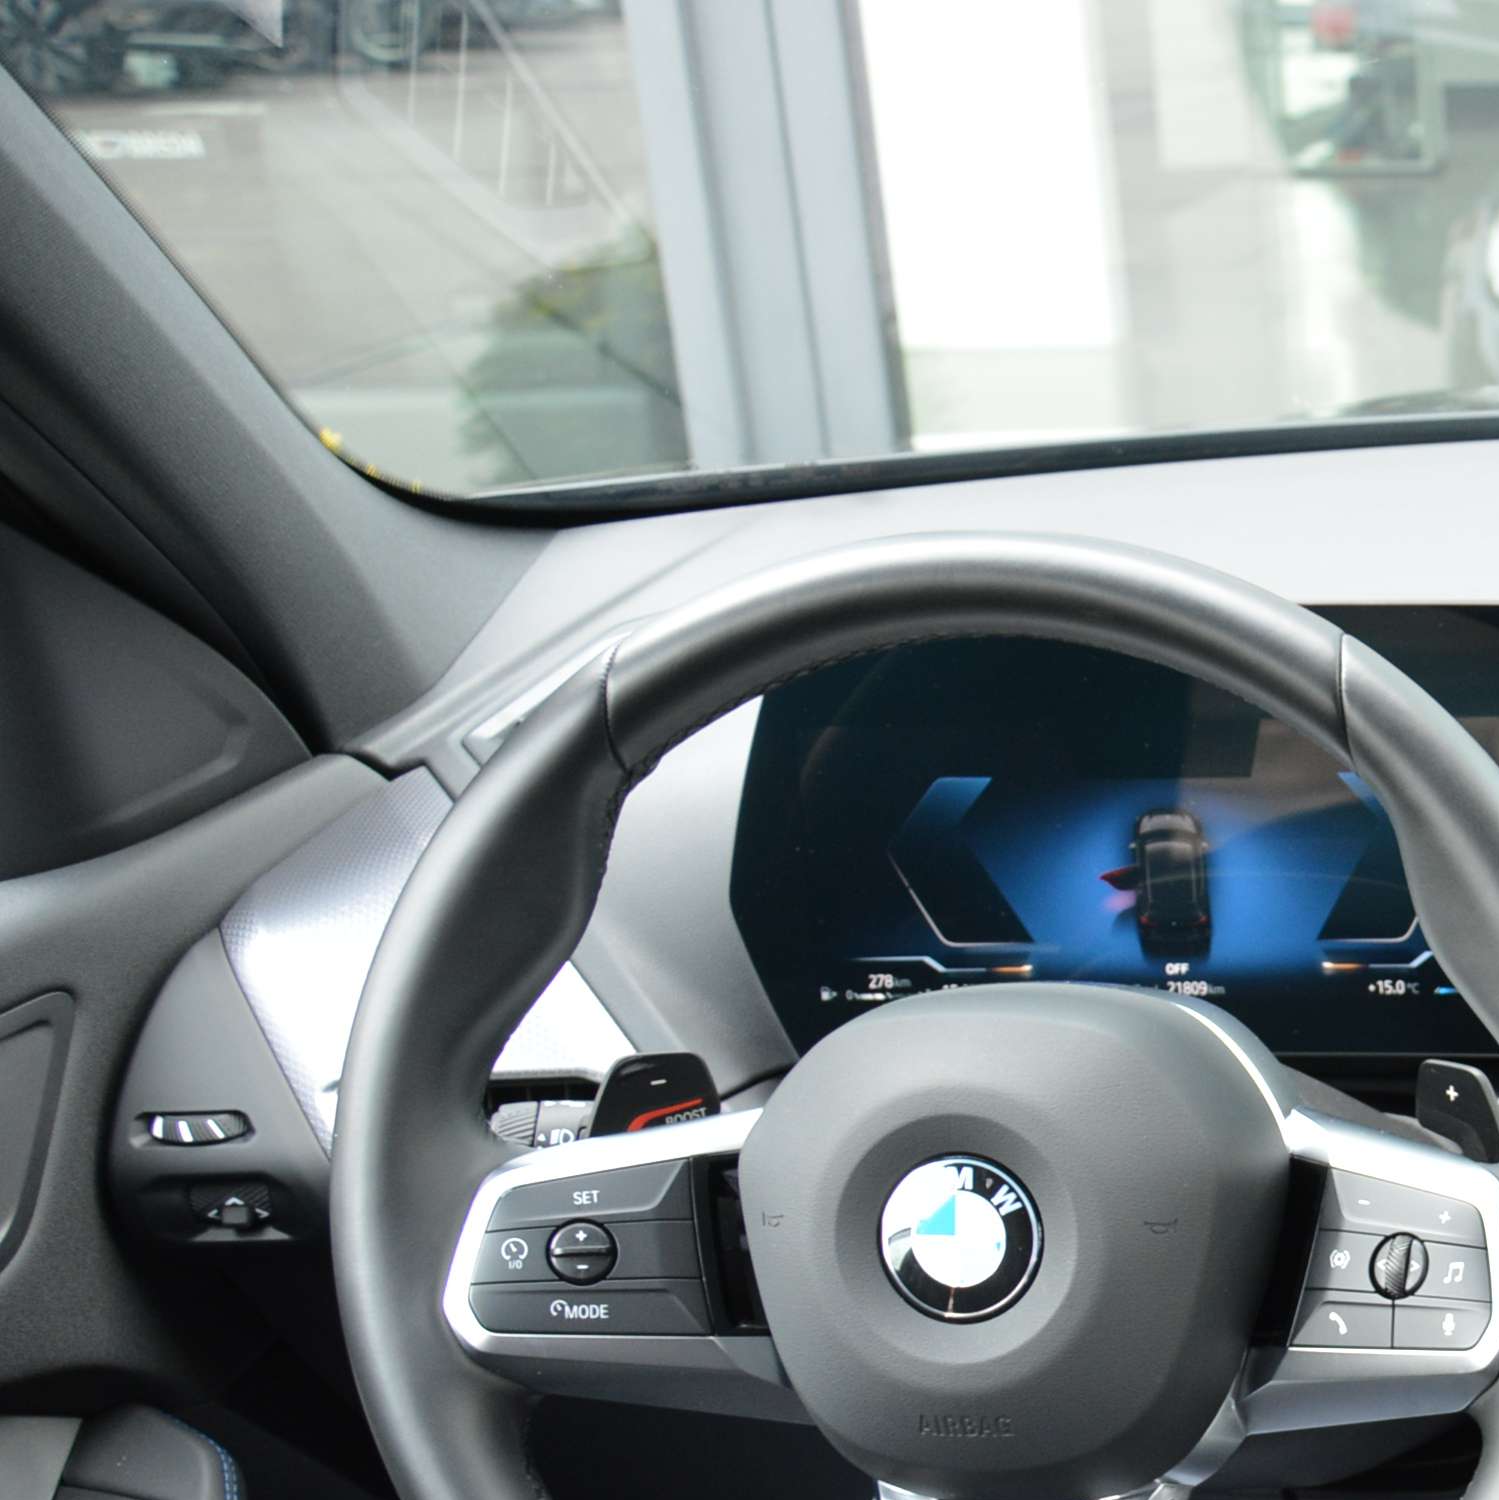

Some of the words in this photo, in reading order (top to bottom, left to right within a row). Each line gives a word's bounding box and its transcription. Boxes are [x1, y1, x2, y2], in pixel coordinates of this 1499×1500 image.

[1165, 962, 1190, 976] OFF
[573, 1190, 600, 1206] SET
[564, 1304, 609, 1319] MODE
